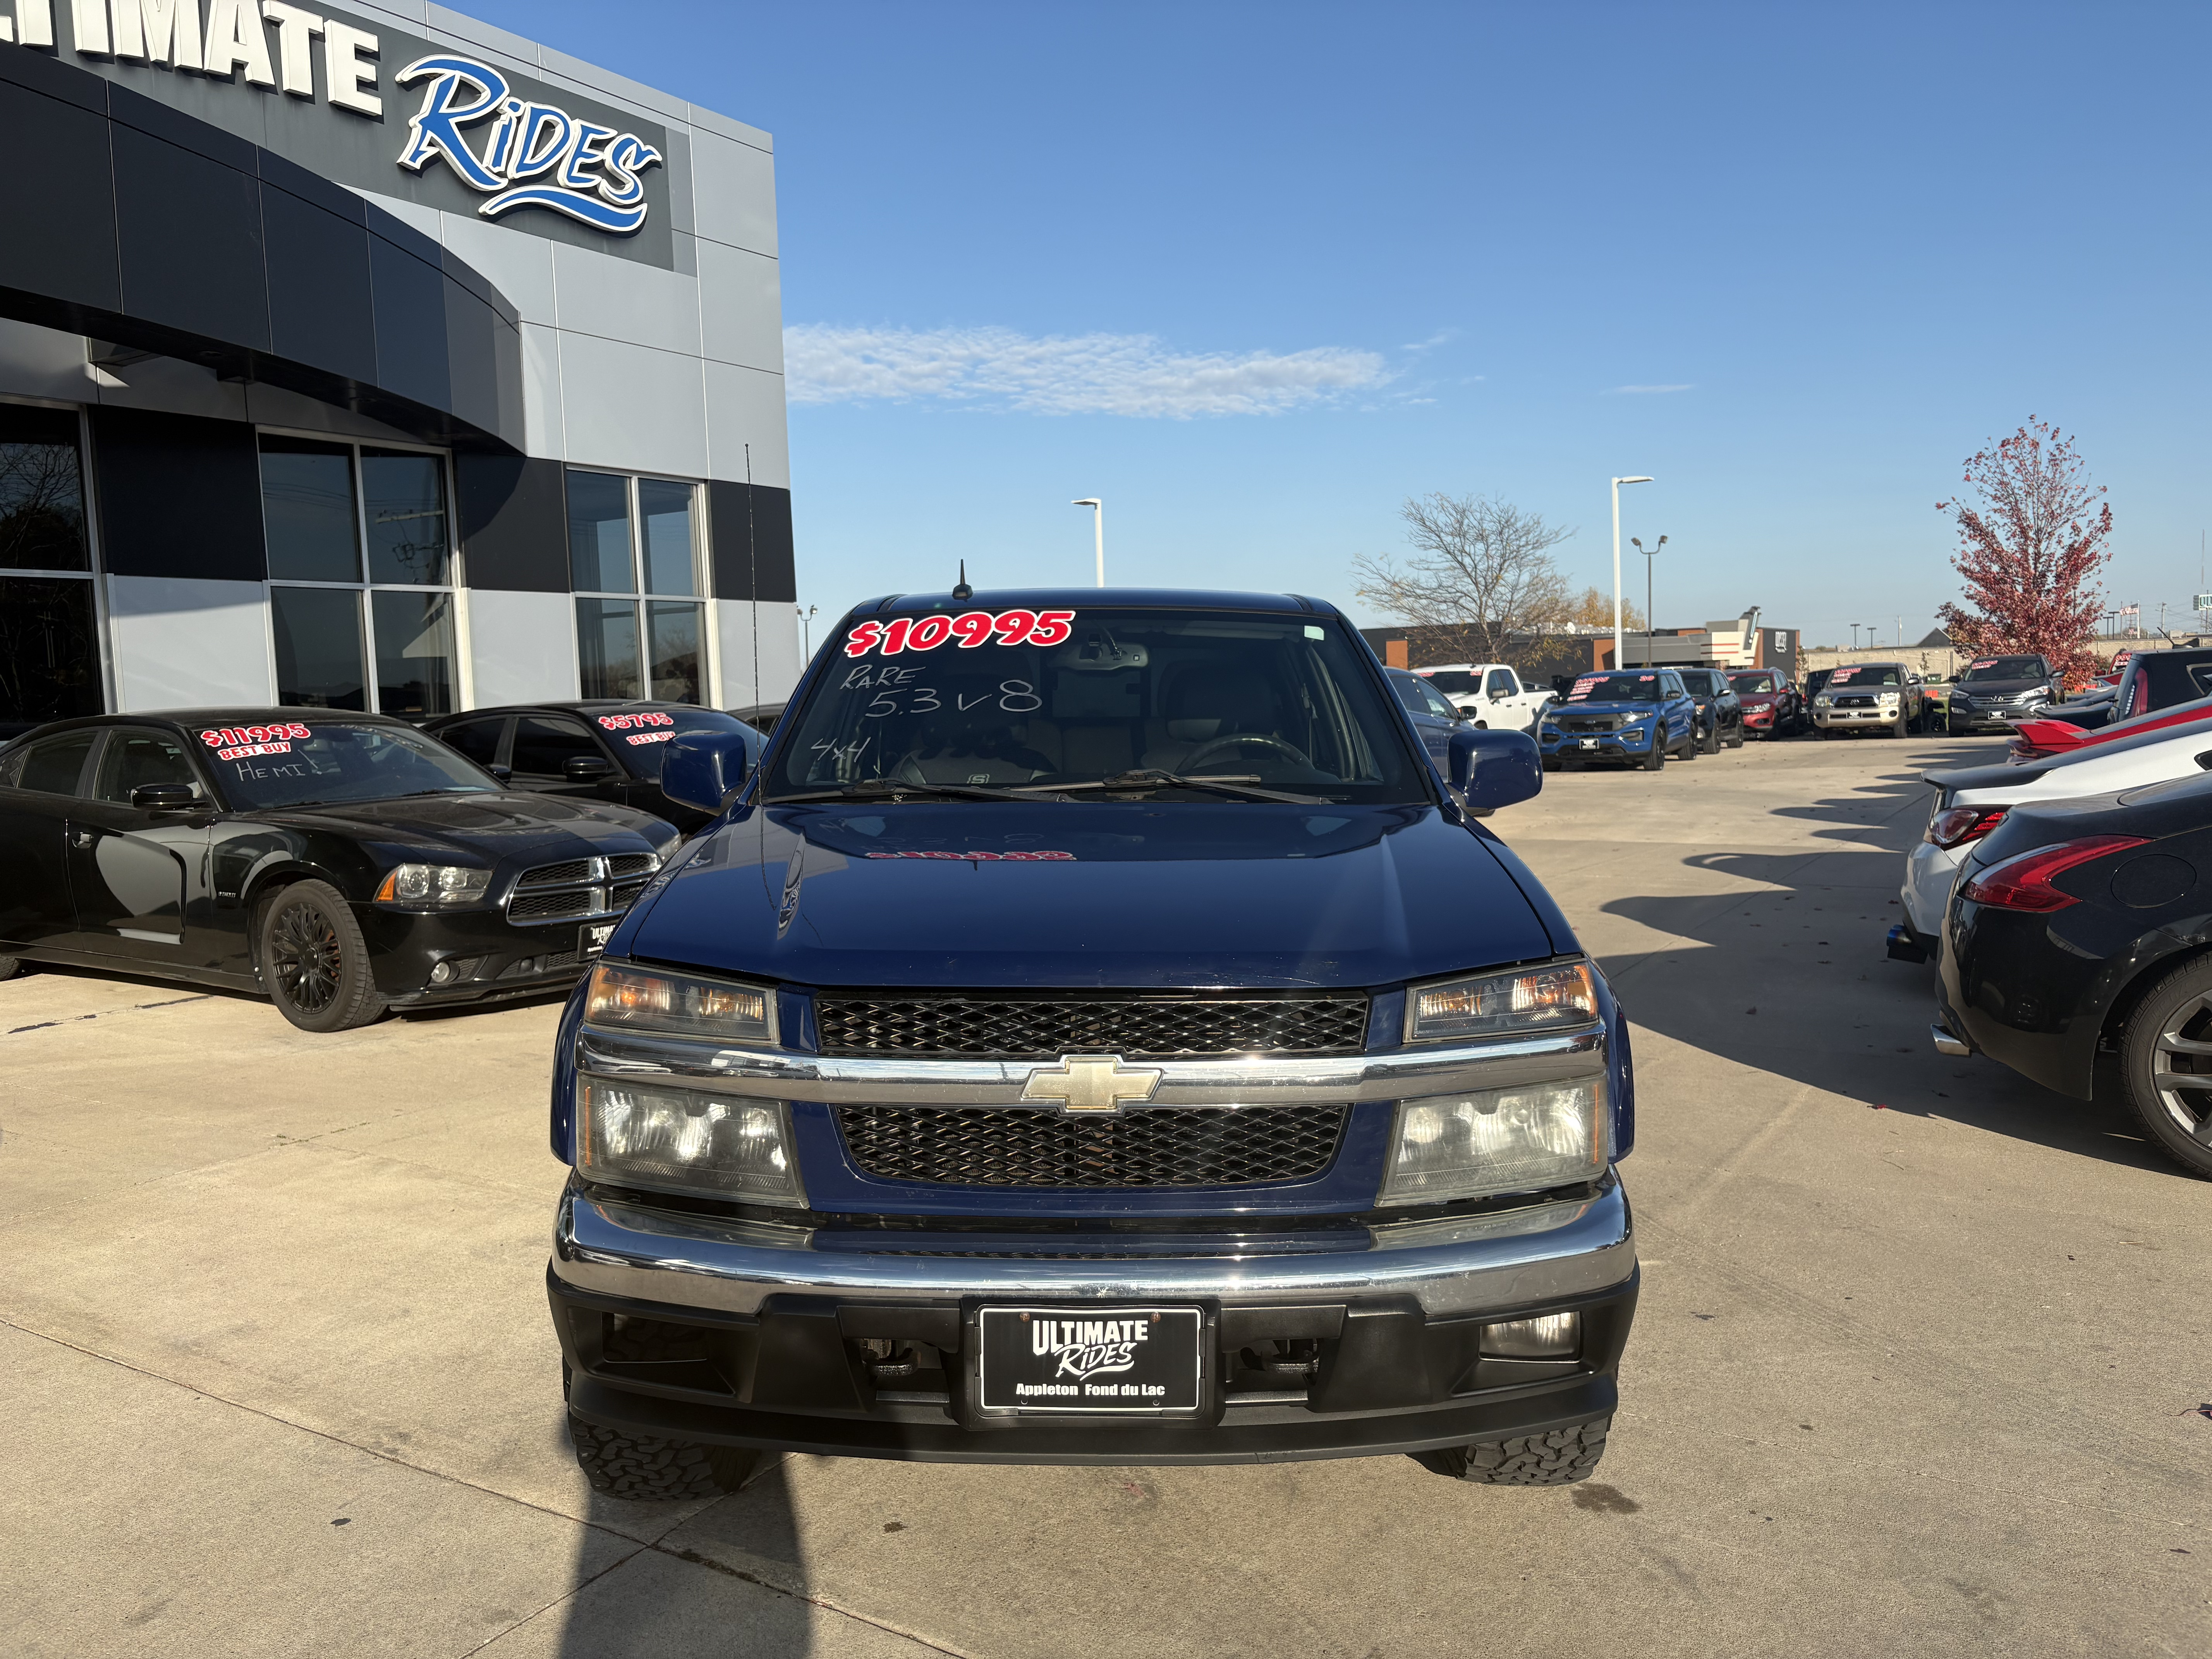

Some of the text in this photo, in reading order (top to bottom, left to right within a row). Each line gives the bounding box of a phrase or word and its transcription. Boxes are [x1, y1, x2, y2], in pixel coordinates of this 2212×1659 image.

[0, 0, 383, 116] IMATE
[844, 609, 1076, 658] $10995
[840, 664, 926, 690] RARE
[865, 688, 941, 717] 5.3
[598, 712, 674, 730] $5795
[201, 723, 311, 747] $11995
[626, 733, 654, 745] BEST
[218, 742, 291, 761] BEST BUY
[1032, 1320, 1148, 1356] ULTIMATE
[1016, 1383, 1165, 1396] Appleton Fond du Lac
